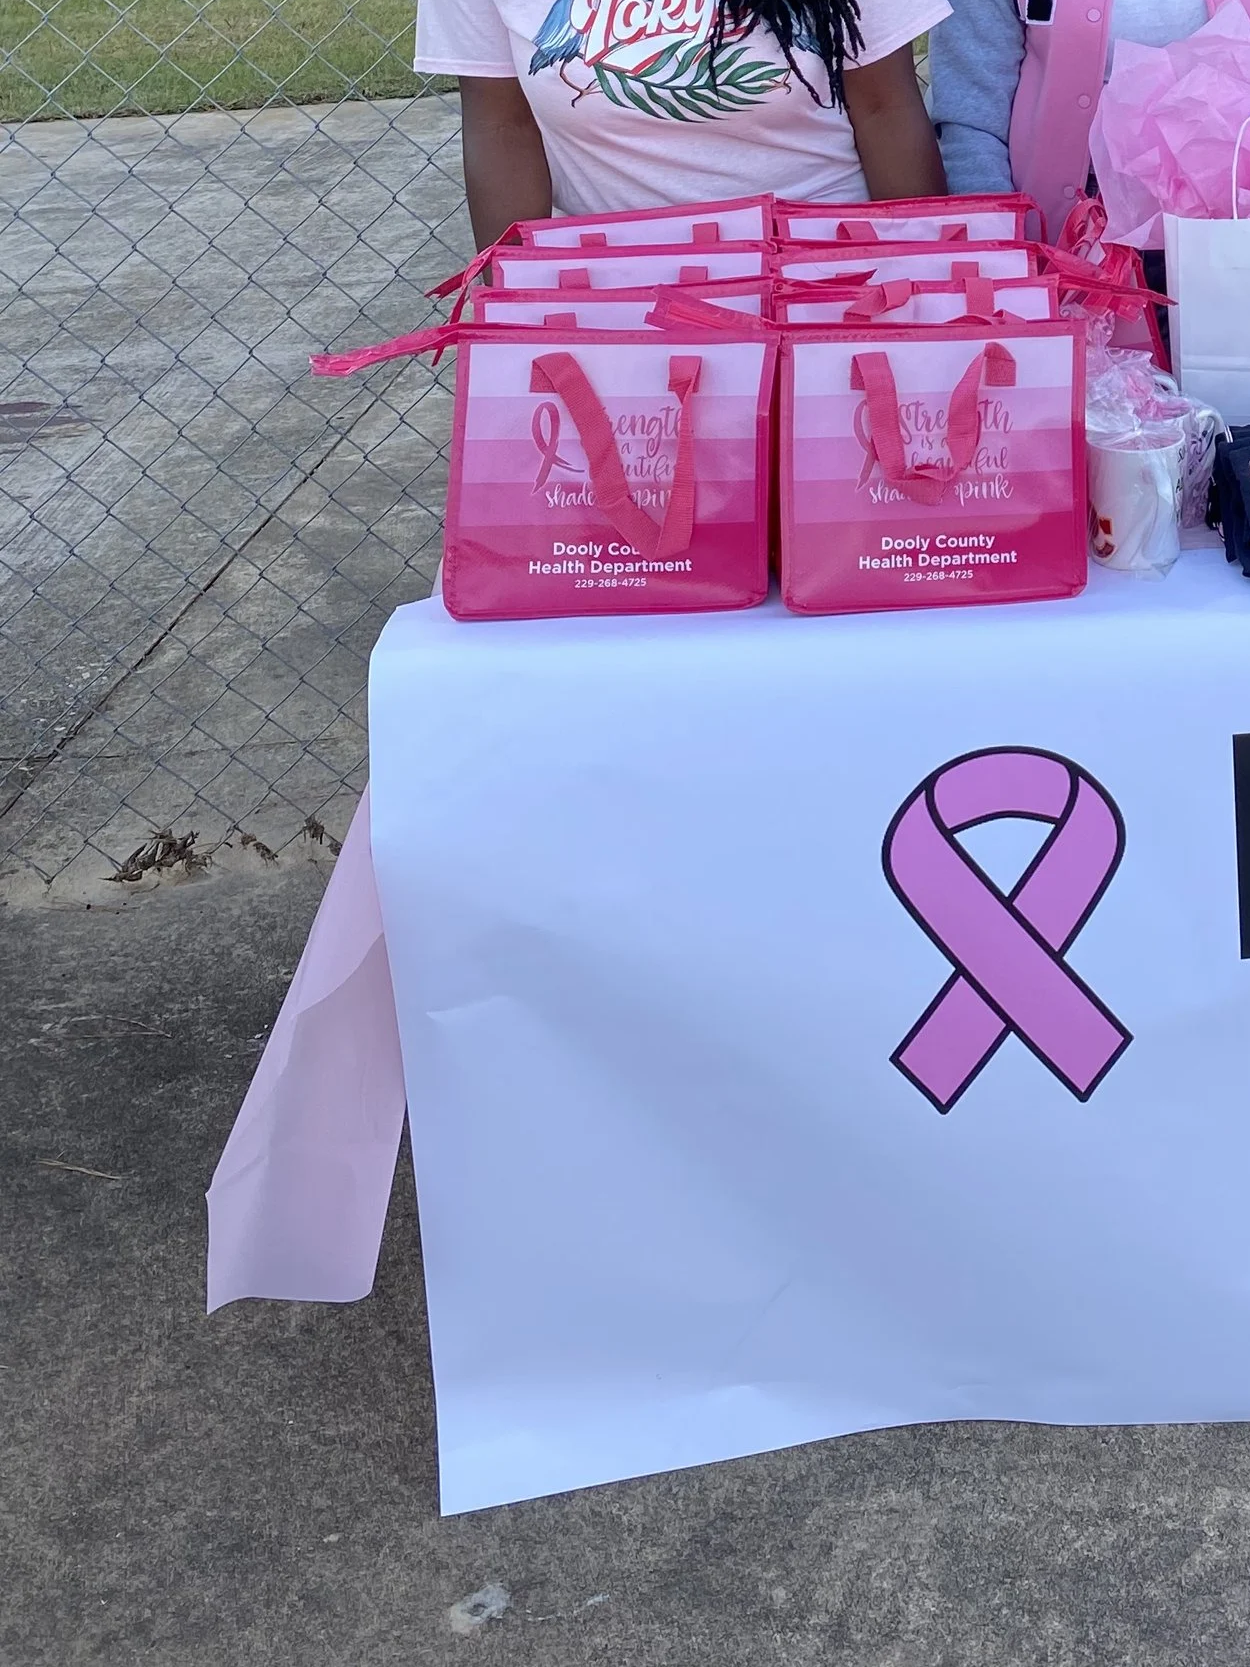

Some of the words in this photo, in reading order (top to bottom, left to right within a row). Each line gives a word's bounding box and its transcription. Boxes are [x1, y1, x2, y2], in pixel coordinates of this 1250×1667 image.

[954, 473, 1014, 507] pink
[553, 541, 603, 559] Dooly
[608, 542, 641, 557] Cou
[881, 535, 930, 551] Dooly
[935, 534, 995, 550] County
[529, 560, 585, 575] Health
[590, 559, 692, 576] Department
[858, 553, 913, 570] Health
[918, 550, 1018, 569] Department
[574, 577, 647, 589] 229-268-4725
[903, 570, 974, 582] 229-268-4725
